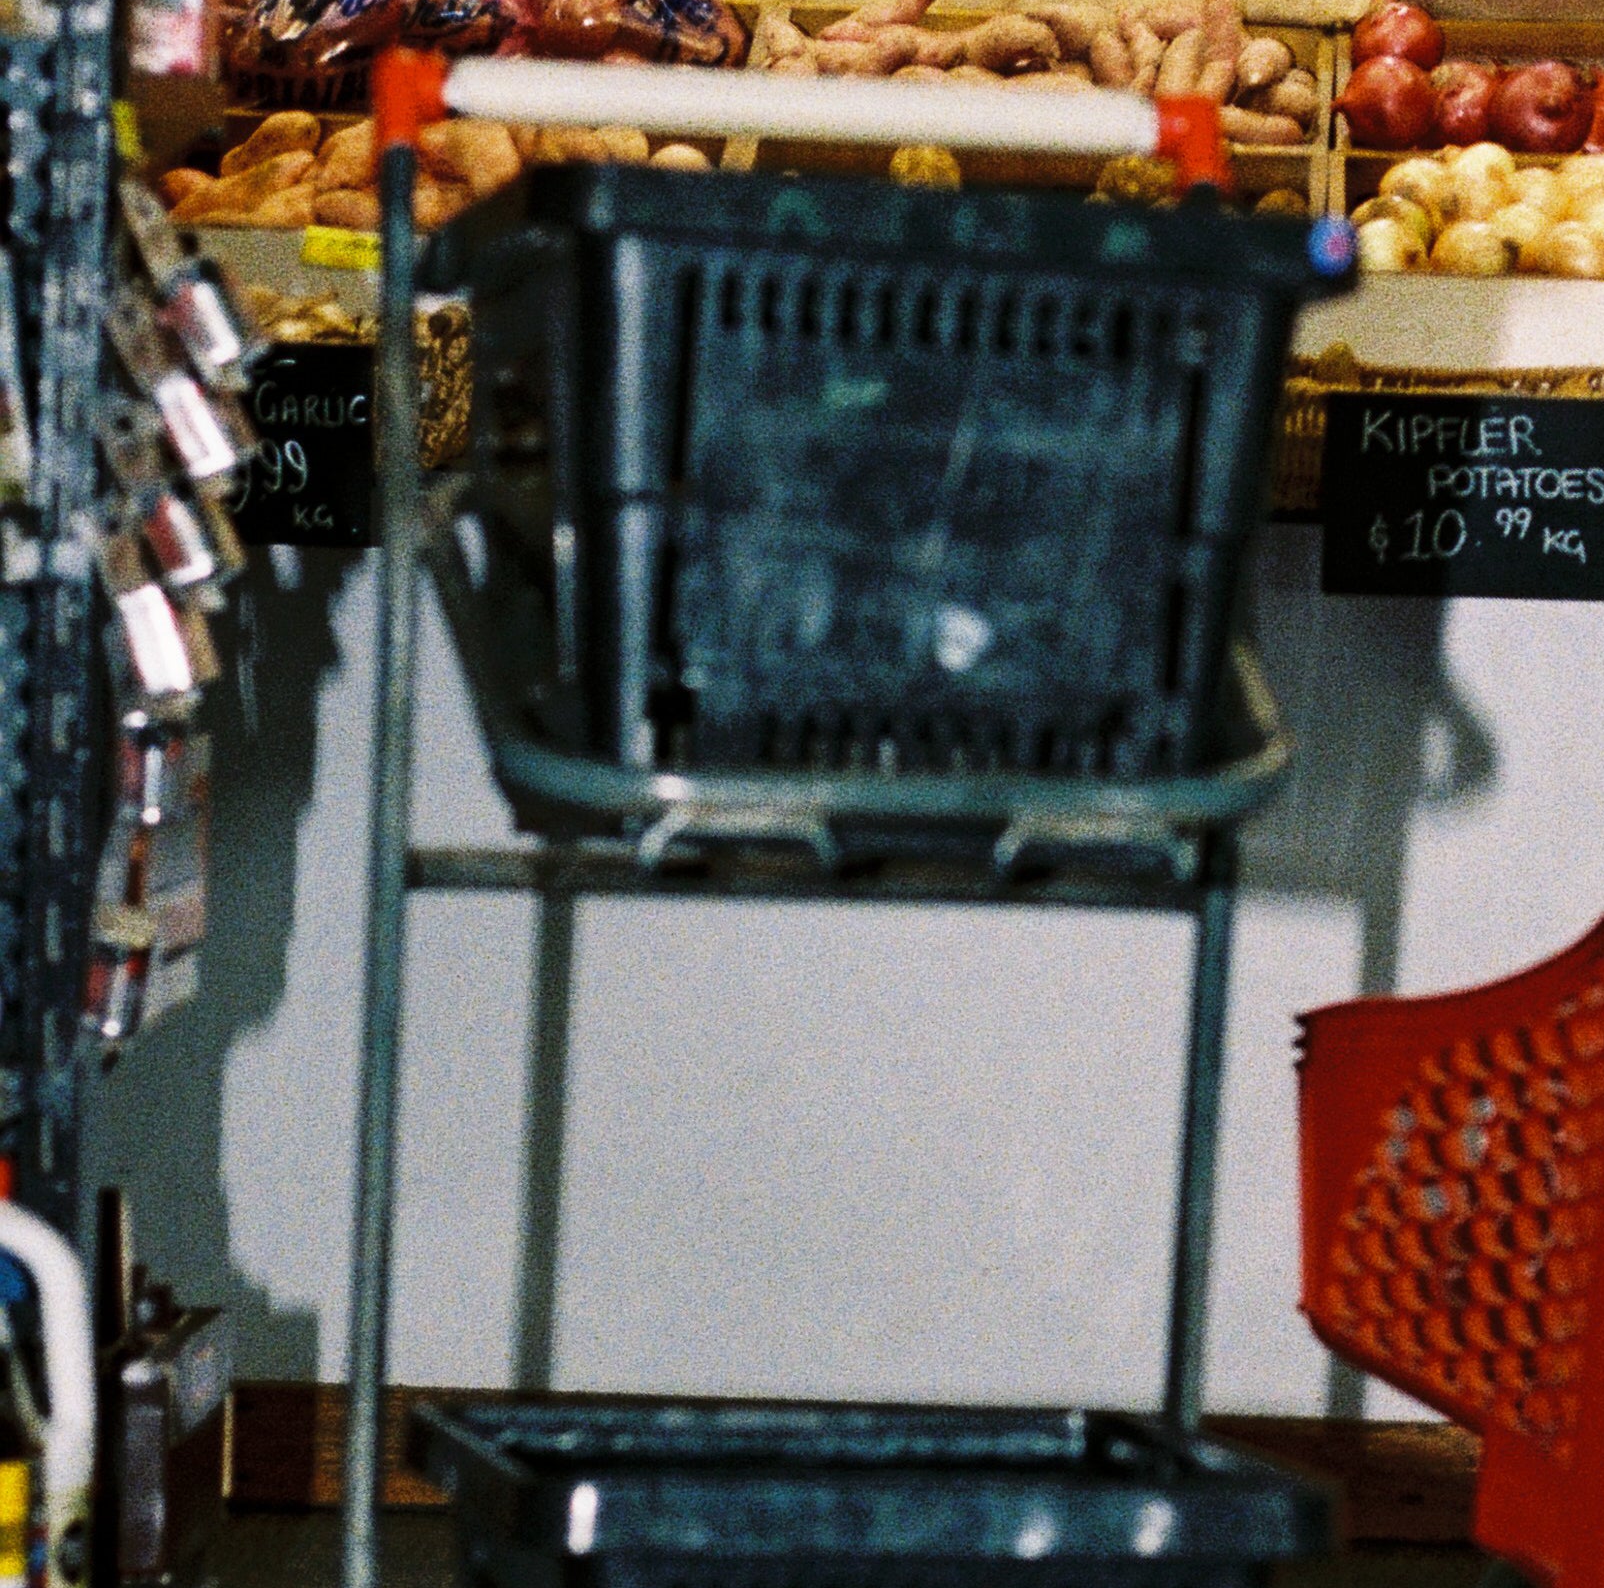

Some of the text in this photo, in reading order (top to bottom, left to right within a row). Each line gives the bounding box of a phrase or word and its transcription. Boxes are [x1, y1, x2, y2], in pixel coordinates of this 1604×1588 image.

[1360, 410, 1544, 457] KIPFLER
[294, 504, 335, 529] KG
[1541, 526, 1588, 564] KG
